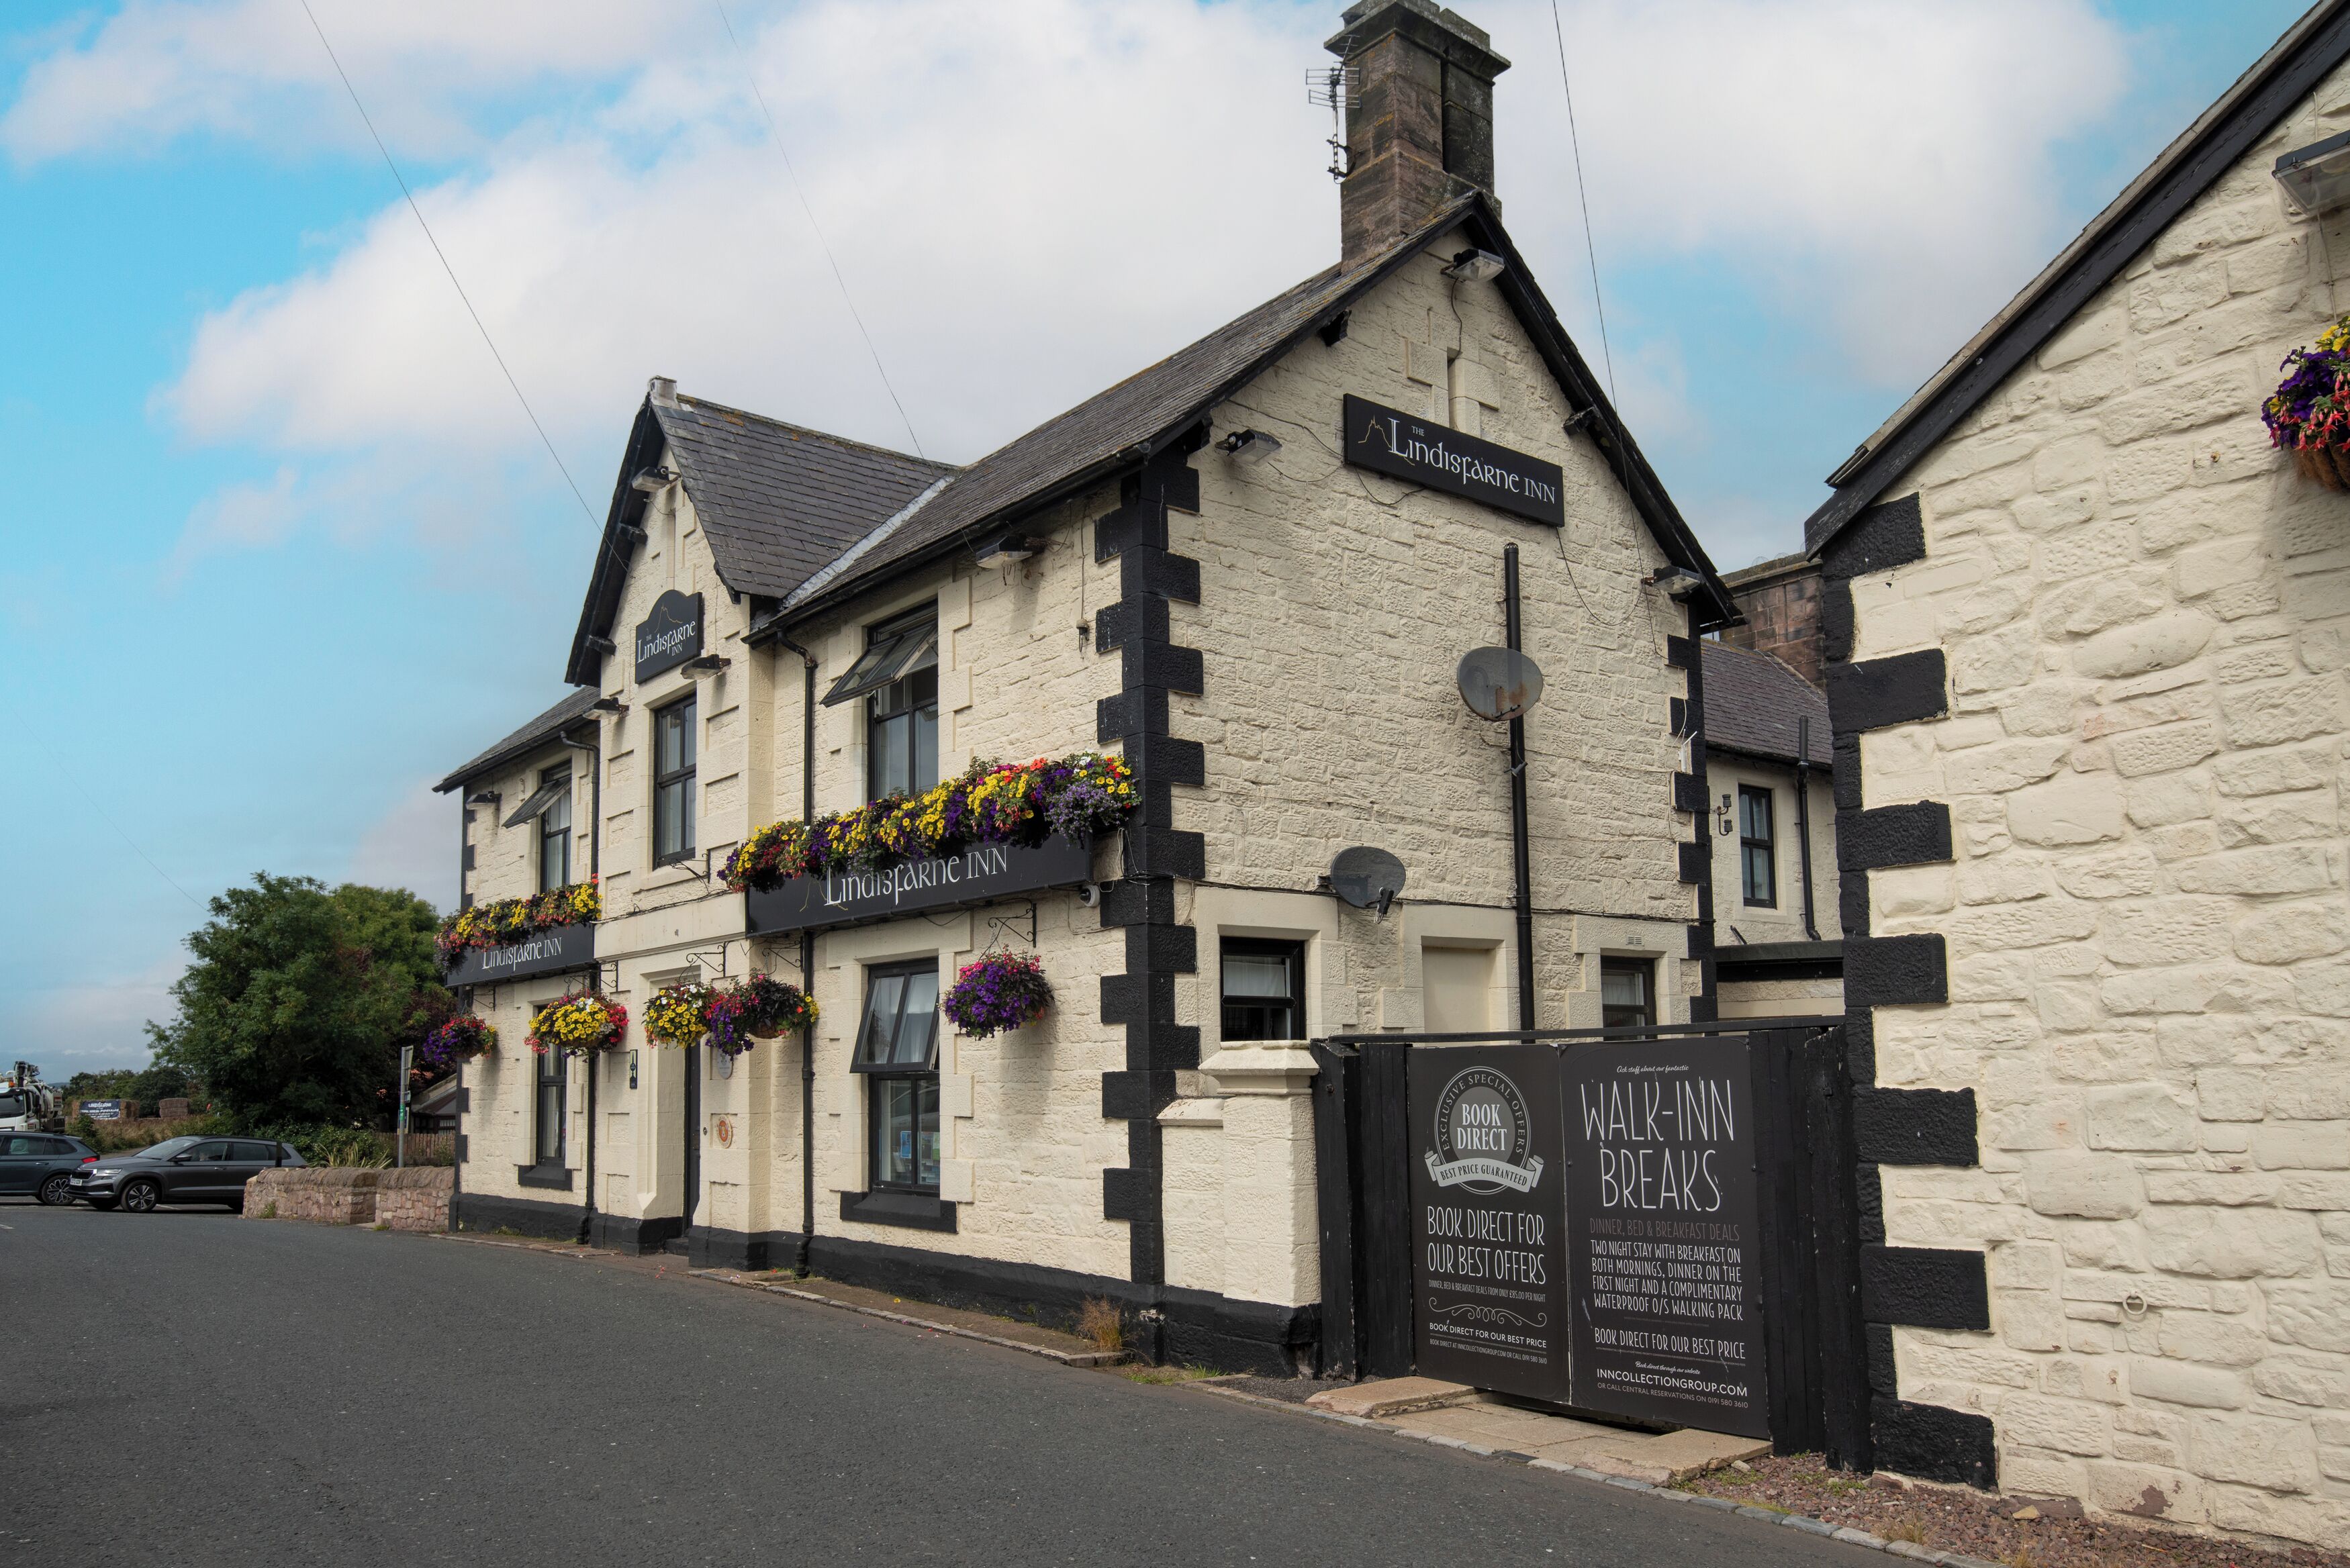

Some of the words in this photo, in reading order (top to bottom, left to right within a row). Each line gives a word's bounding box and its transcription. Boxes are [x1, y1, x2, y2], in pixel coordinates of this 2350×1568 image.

[1411, 426, 1425, 436] THE
[1387, 418, 1519, 493] Lindisfarne
[1524, 477, 1555, 504] INN
[637, 621, 696, 664] Lindisfarne
[671, 643, 683, 656] INN
[966, 846, 1007, 879] INN
[544, 937, 562, 958] INN
[1617, 1065, 1628, 1073] Ask
[1628, 1066, 1640, 1074] staff
[1665, 1065, 1689, 1073] fantastic
[1440, 1080, 1466, 1150] EXCLUSIVE
[1468, 1074, 1510, 1099] SPECIAL
[1512, 1100, 1525, 1155] OFFERS
[1462, 1104, 1501, 1126] BOOK
[1581, 1079, 1734, 1140] WALK-INN
[1456, 1128, 1507, 1150] DIRECT
[1440, 1167, 1457, 1181] BEST
[1458, 1164, 1479, 1176] PRICE
[1480, 1164, 1528, 1186] GUARANTEED
[1600, 1147, 1720, 1212] BREAKS
[1427, 1206, 1463, 1238] BOOK
[1467, 1209, 1513, 1242] DIRECT
[1518, 1213, 1545, 1246] FOR
[1590, 1218, 1625, 1236] DINNER,
[1627, 1219, 1644, 1236] BED
[1647, 1220, 1653, 1236] &
[1656, 1220, 1706, 1240] BREAKFAST
[1709, 1223, 1740, 1241] DEALS
[1427, 1242, 1454, 1273] OUR
[1458, 1245, 1491, 1278] BEST
[1495, 1249, 1546, 1285] OFFERS
[1591, 1239, 1607, 1255] TWO
[1609, 1240, 1632, 1257] NIGHT
[1634, 1242, 1652, 1257] STAY
[1654, 1243, 1675, 1259] WITH
[1677, 1244, 1726, 1263] BREAKFAST
[1727, 1248, 1741, 1263] ON
[1591, 1257, 1613, 1273] BOTH
[1616, 1259, 1664, 1278] MORNINGS,
[1667, 1262, 1703, 1280] DINNER
[1705, 1265, 1720, 1281] ON
[1722, 1265, 1742, 1283] THE
[1429, 1279, 1444, 1289] DINNER,
[1455, 1283, 1475, 1293] BREAKFAST
[1476, 1285, 1487, 1295] DEALS
[1488, 1287, 1499, 1296] FROM
[1499, 1288, 1509, 1297] ONLY
[1509, 1290, 1524, 1300] £85.00
[1525, 1292, 1533, 1301] PER
[1533, 1293, 1546, 1302] NIGHT
[1593, 1275, 1613, 1291] FIRST
[1615, 1277, 1639, 1293] NIGHT
[1642, 1279, 1659, 1295] AND
[1661, 1280, 1667, 1295] A
[1669, 1281, 1742, 1302] COMPLIMENTARY
[1594, 1293, 1649, 1312] WATERPROOF
[1652, 1297, 1669, 1316] O/S
[1672, 1299, 1714, 1318] WALKING
[1718, 1303, 1744, 1321] PACK
[1429, 1322, 1448, 1332] BOOK
[1450, 1326, 1474, 1336] DIRECT
[1475, 1330, 1489, 1339] FOR
[1491, 1332, 1506, 1342] OUR
[1507, 1334, 1524, 1344] BEST
[1526, 1337, 1547, 1348] PRICE
[1595, 1328, 1617, 1345] BOOK
[1619, 1330, 1649, 1349] DIRECT
[1652, 1333, 1668, 1351] FOR
[1671, 1335, 1689, 1353] OUR
[1692, 1336, 1715, 1356] BEST
[1718, 1340, 1746, 1359] PRICE
[1440, 1340, 1452, 1348] DIRECT
[1457, 1343, 1506, 1357] INNCOLLECTIONGROUP.COM
[1512, 1352, 1522, 1360] CALL
[1538, 1357, 1548, 1365] 3610
[1597, 1368, 1748, 1397] INNCOLLECTIONGROUP.COM
[1659, 1365, 1677, 1374] through
[1607, 1383, 1621, 1391] CALL
[1622, 1385, 1650, 1395] CENTRAL
[1650, 1389, 1695, 1402] RESERVATIONS
[1707, 1397, 1720, 1405] 0191
[1721, 1398, 1732, 1407] 580
[1734, 1400, 1748, 1408] 3610
